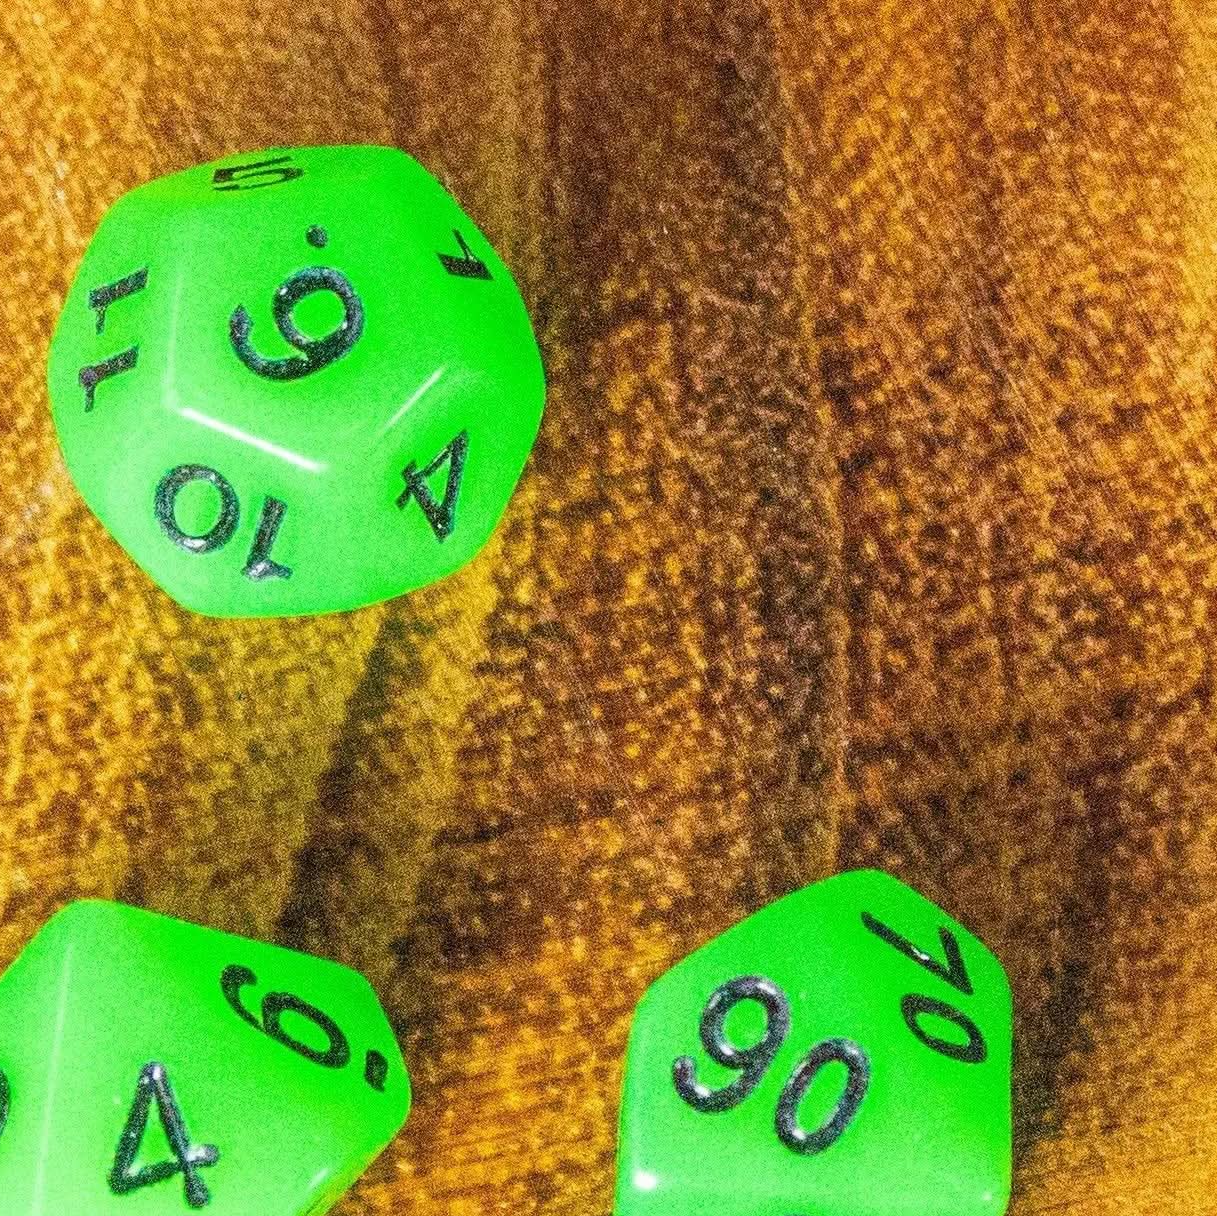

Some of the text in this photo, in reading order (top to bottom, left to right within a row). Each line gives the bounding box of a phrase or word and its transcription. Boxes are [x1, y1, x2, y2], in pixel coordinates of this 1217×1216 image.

[212, 157, 304, 191] 5
[78, 266, 149, 412] 11
[153, 463, 294, 580] 10
[395, 429, 470, 544] 4
[861, 911, 987, 1064] 70
[107, 1061, 221, 1209] 4
[671, 974, 872, 1157] 90
